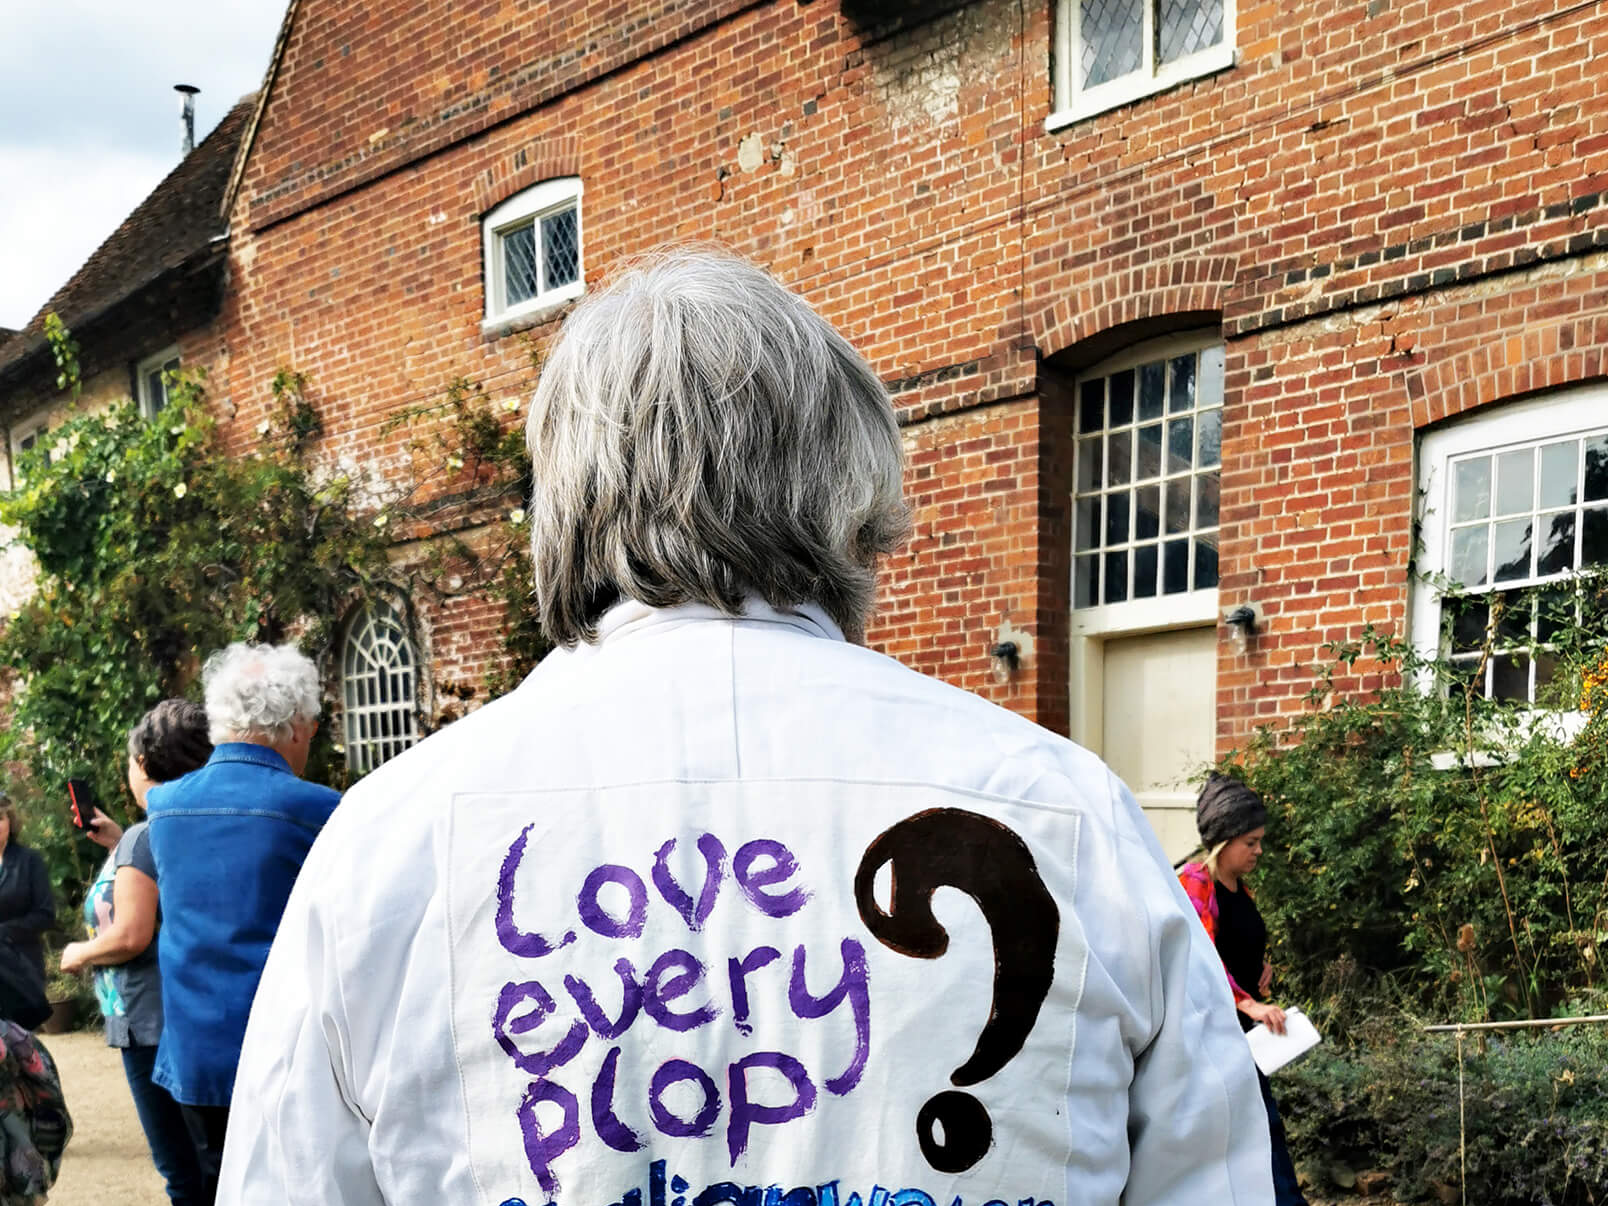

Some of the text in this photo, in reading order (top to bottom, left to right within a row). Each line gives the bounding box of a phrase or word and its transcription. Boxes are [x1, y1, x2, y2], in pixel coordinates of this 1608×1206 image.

[495, 823, 815, 958] Love
[492, 936, 870, 1096] every
[854, 807, 1061, 1173] ?
[516, 1046, 817, 1198] plop
